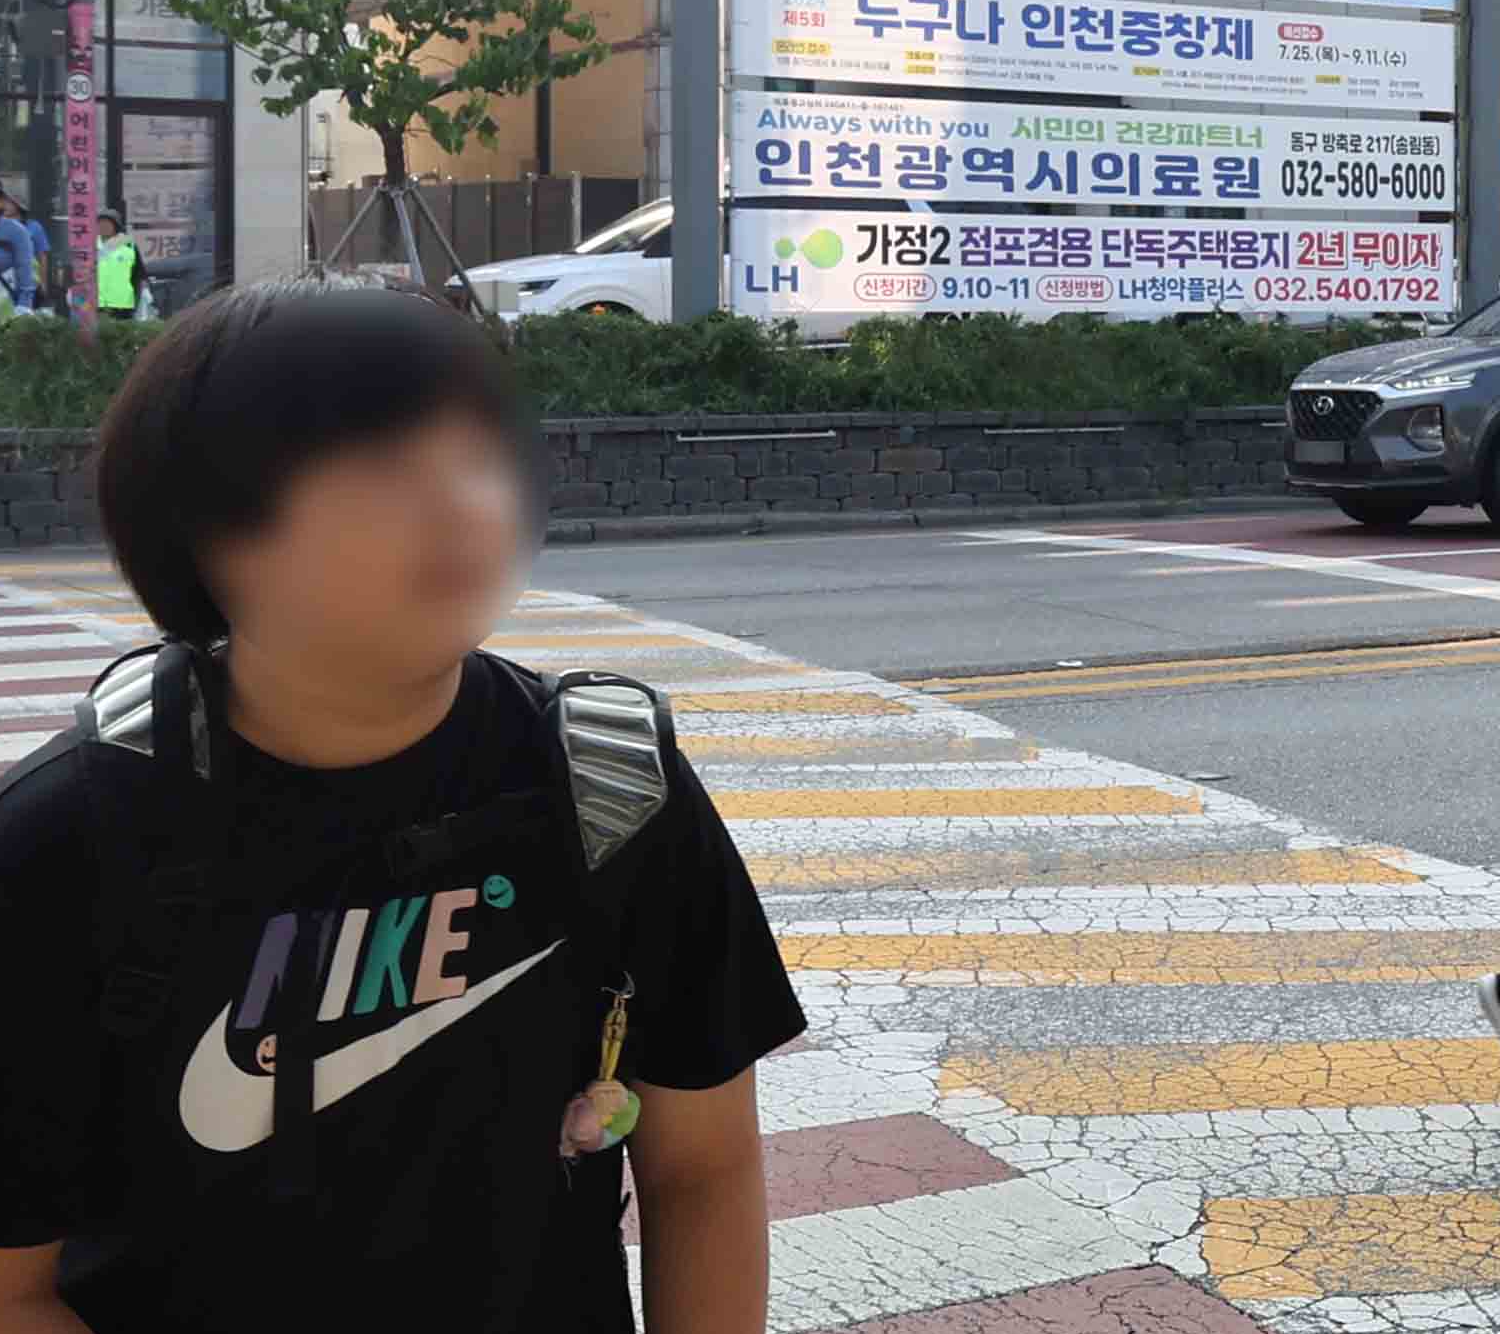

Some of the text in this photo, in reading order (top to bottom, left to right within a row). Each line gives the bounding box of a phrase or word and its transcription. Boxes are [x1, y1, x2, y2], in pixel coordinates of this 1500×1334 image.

[781, 10, 826, 29] 제5회
[1021, 2, 1254, 61] 인천중창제
[69, 78, 91, 96] 30
[756, 107, 1264, 148] Always with you 시민의 건강파트너
[1290, 131, 1318, 154] 동구
[1322, 133, 1362, 155] 방축로
[754, 138, 1262, 199] 인천광역시의료원
[1281, 160, 1446, 201] 032-580-6000
[856, 224, 1442, 270] 가정2 점포겸용 단독주택용지 2년 무이자
[744, 264, 799, 293] LH
[862, 275, 1441, 303] 신청기간 9.10~11 신청방법 LH청약플러스 032.540.1792
